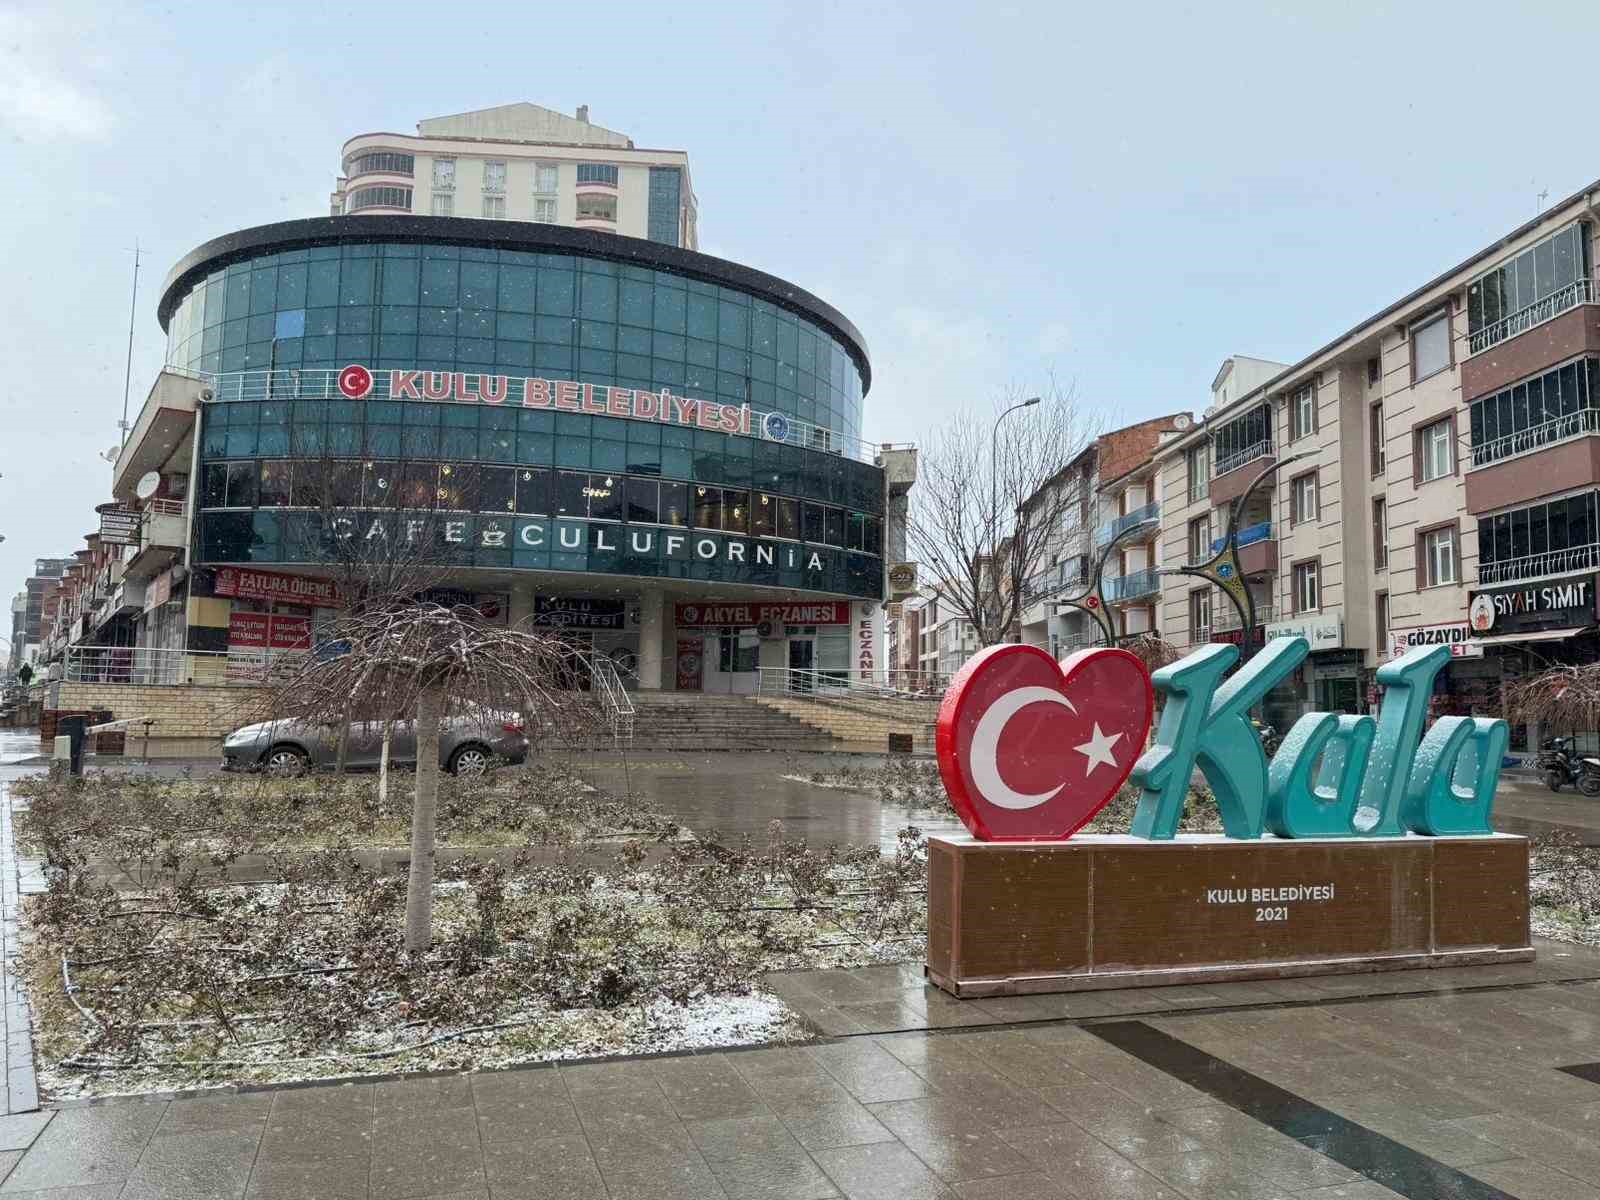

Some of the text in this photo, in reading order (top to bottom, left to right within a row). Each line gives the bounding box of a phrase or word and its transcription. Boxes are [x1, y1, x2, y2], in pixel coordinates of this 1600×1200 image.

[390, 369, 752, 434] KULU BELEDİYESİ
[332, 517, 465, 543] CAFE
[540, 600, 591, 612] KULU
[703, 606, 752, 622] AKYEL
[859, 620, 873, 679] ECZANE
[1207, 882, 1335, 904] KULU BELEDİYESİ
[1255, 907, 1289, 921] 2021
